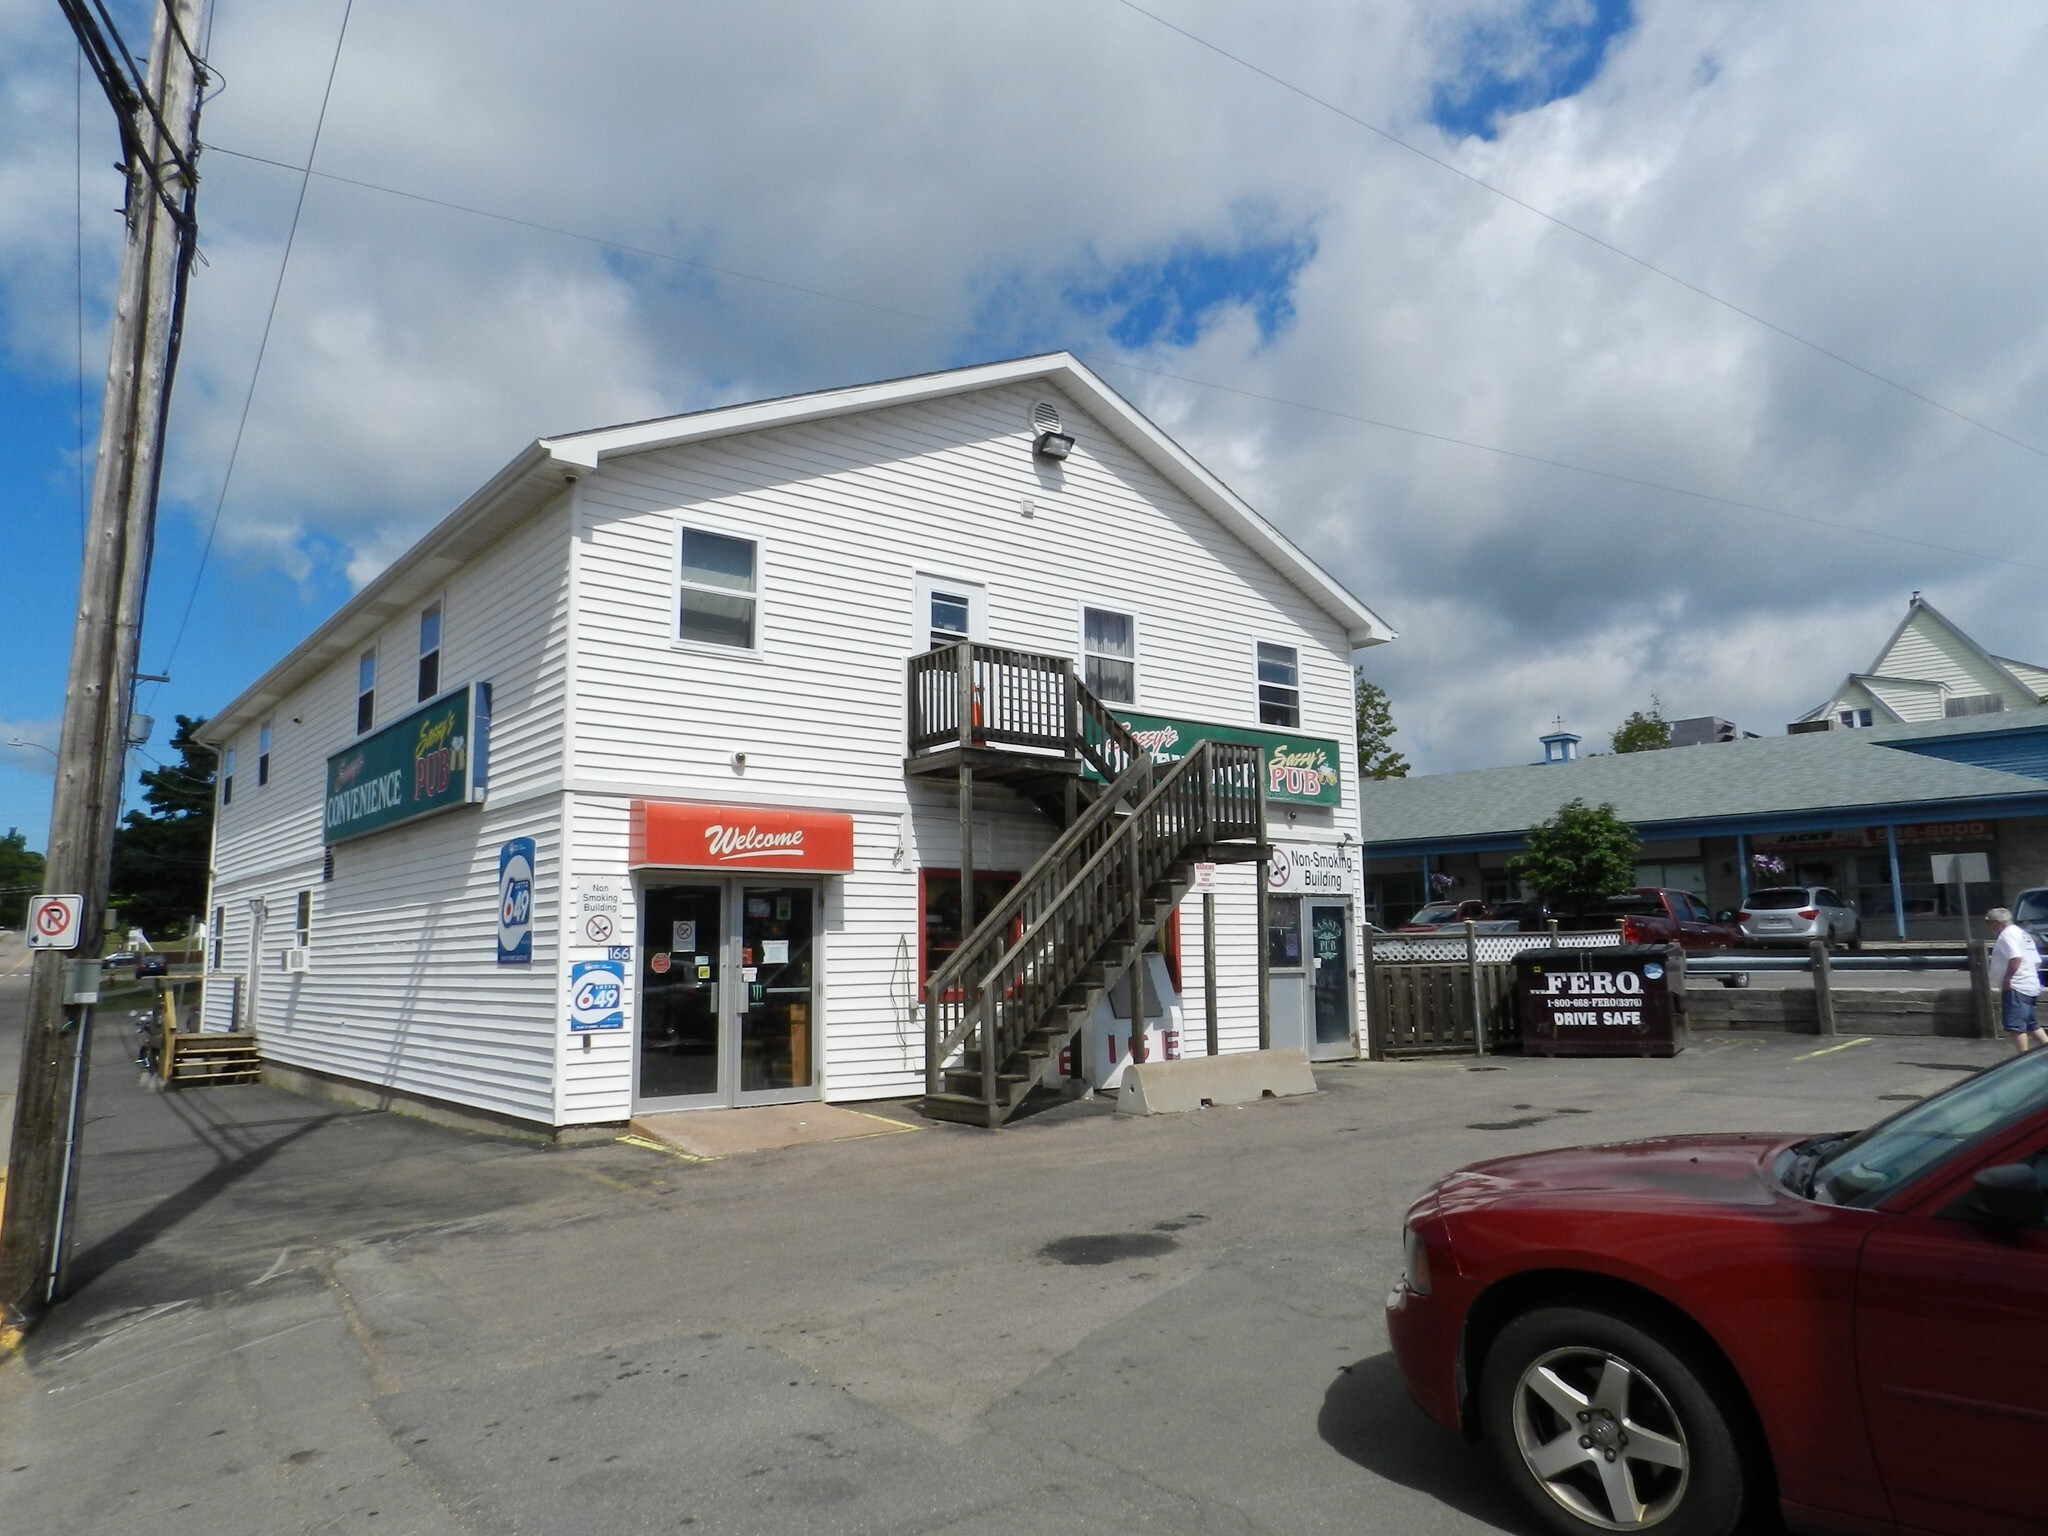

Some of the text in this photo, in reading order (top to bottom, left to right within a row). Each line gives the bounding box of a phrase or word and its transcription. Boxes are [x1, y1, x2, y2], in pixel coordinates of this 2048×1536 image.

[1269, 745, 1327, 770] Sassy's
[415, 747, 450, 801] PUB
[1270, 765, 1321, 796] PUB
[327, 769, 402, 828] CONVENIENCE
[705, 825, 804, 855] Welcome
[1291, 850, 1352, 872] Non-Smoking
[592, 884, 609, 892] Non
[1304, 870, 1342, 890] Building
[583, 893, 618, 904] Smoking
[584, 903, 618, 913] Building
[609, 947, 630, 960] 166
[1320, 940, 1336, 951] PUB
[1554, 1011, 1642, 1026] DRIVE SAFE
